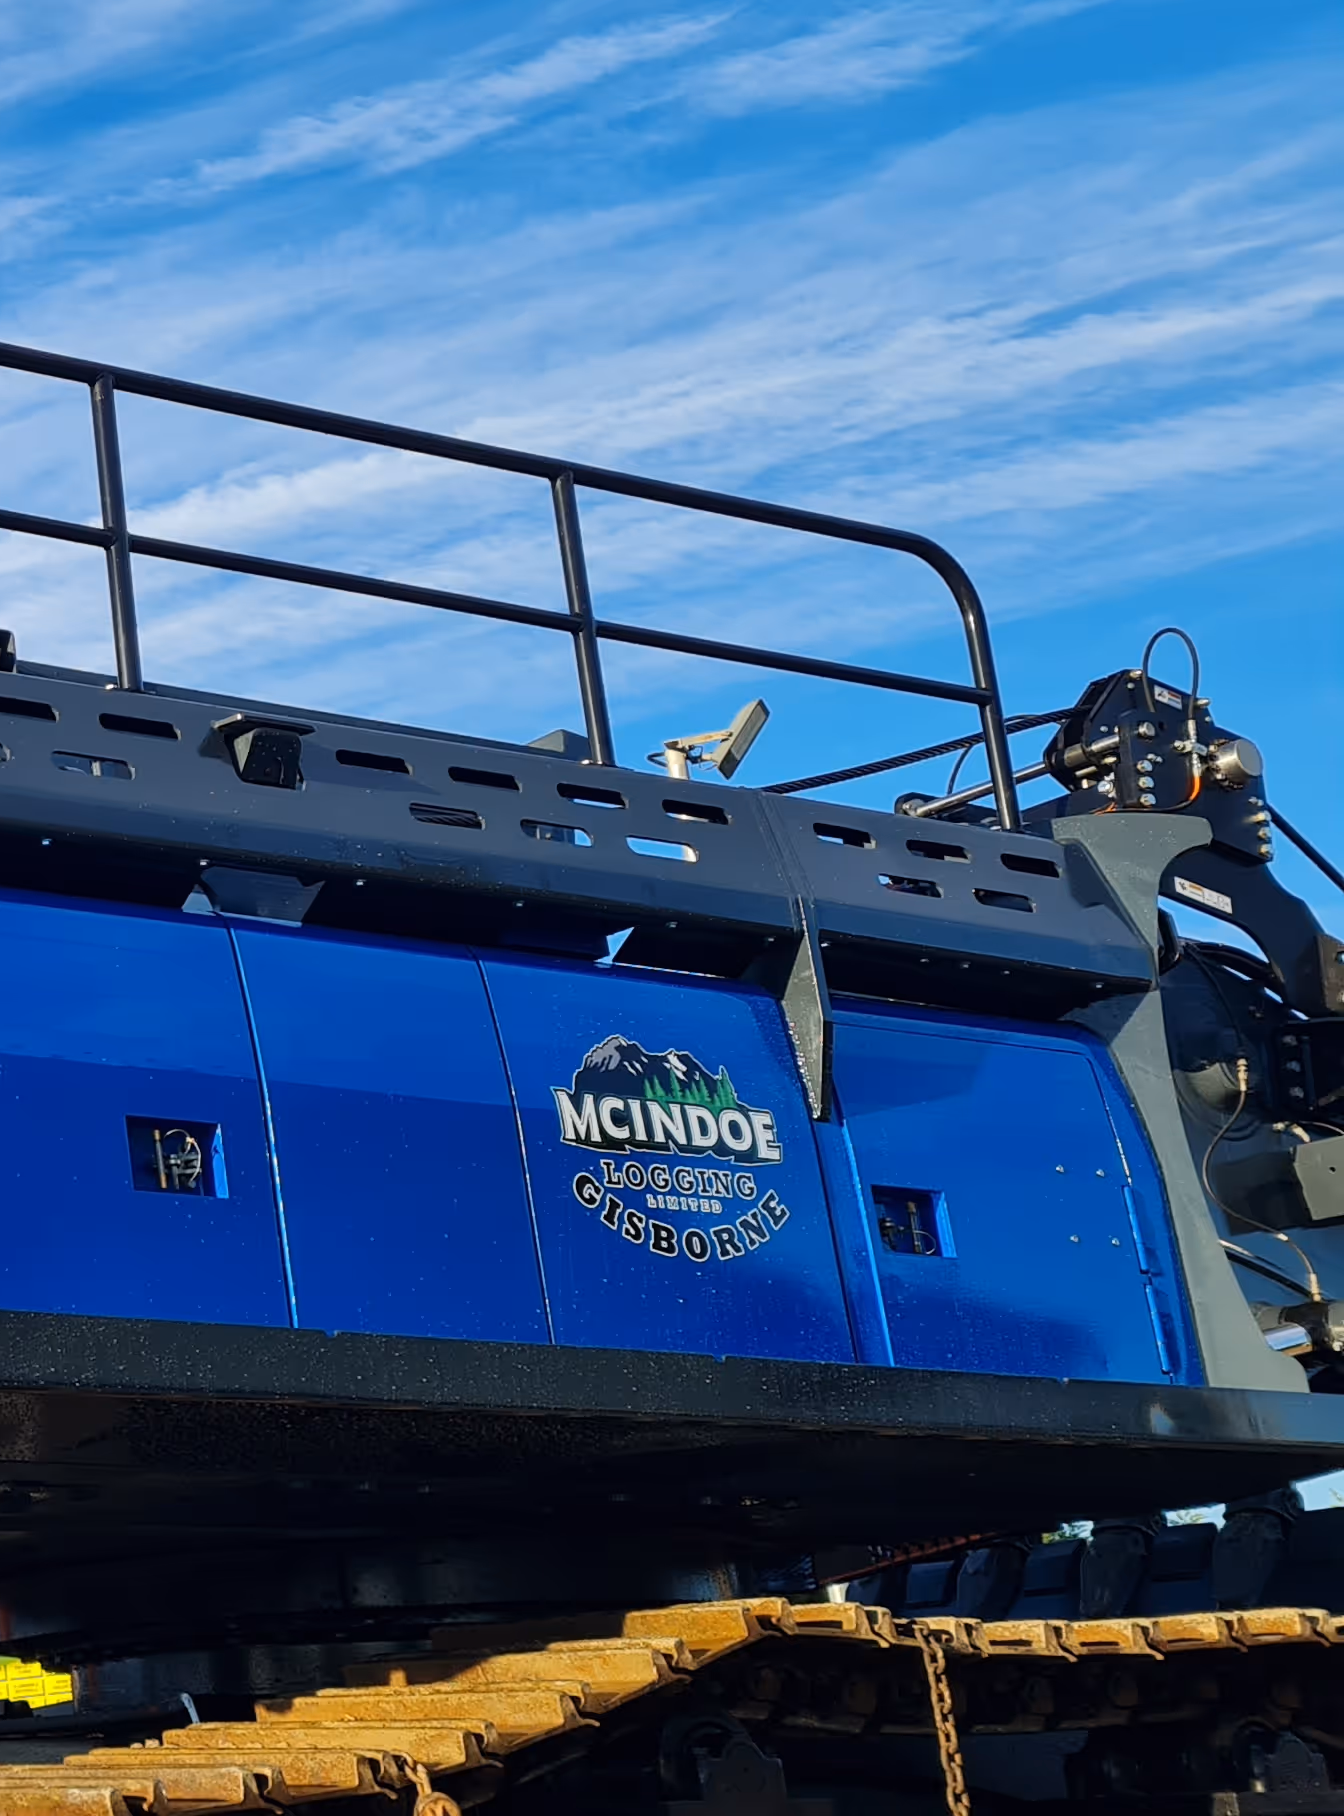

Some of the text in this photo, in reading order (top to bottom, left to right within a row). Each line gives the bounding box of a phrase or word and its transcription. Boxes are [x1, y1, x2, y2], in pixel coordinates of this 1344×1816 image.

[553, 1088, 783, 1162] MCINDOE
[601, 1159, 757, 1199] LOGGING
[646, 1194, 723, 1214] LIMITED
[573, 1172, 790, 1262] GISBORNE
